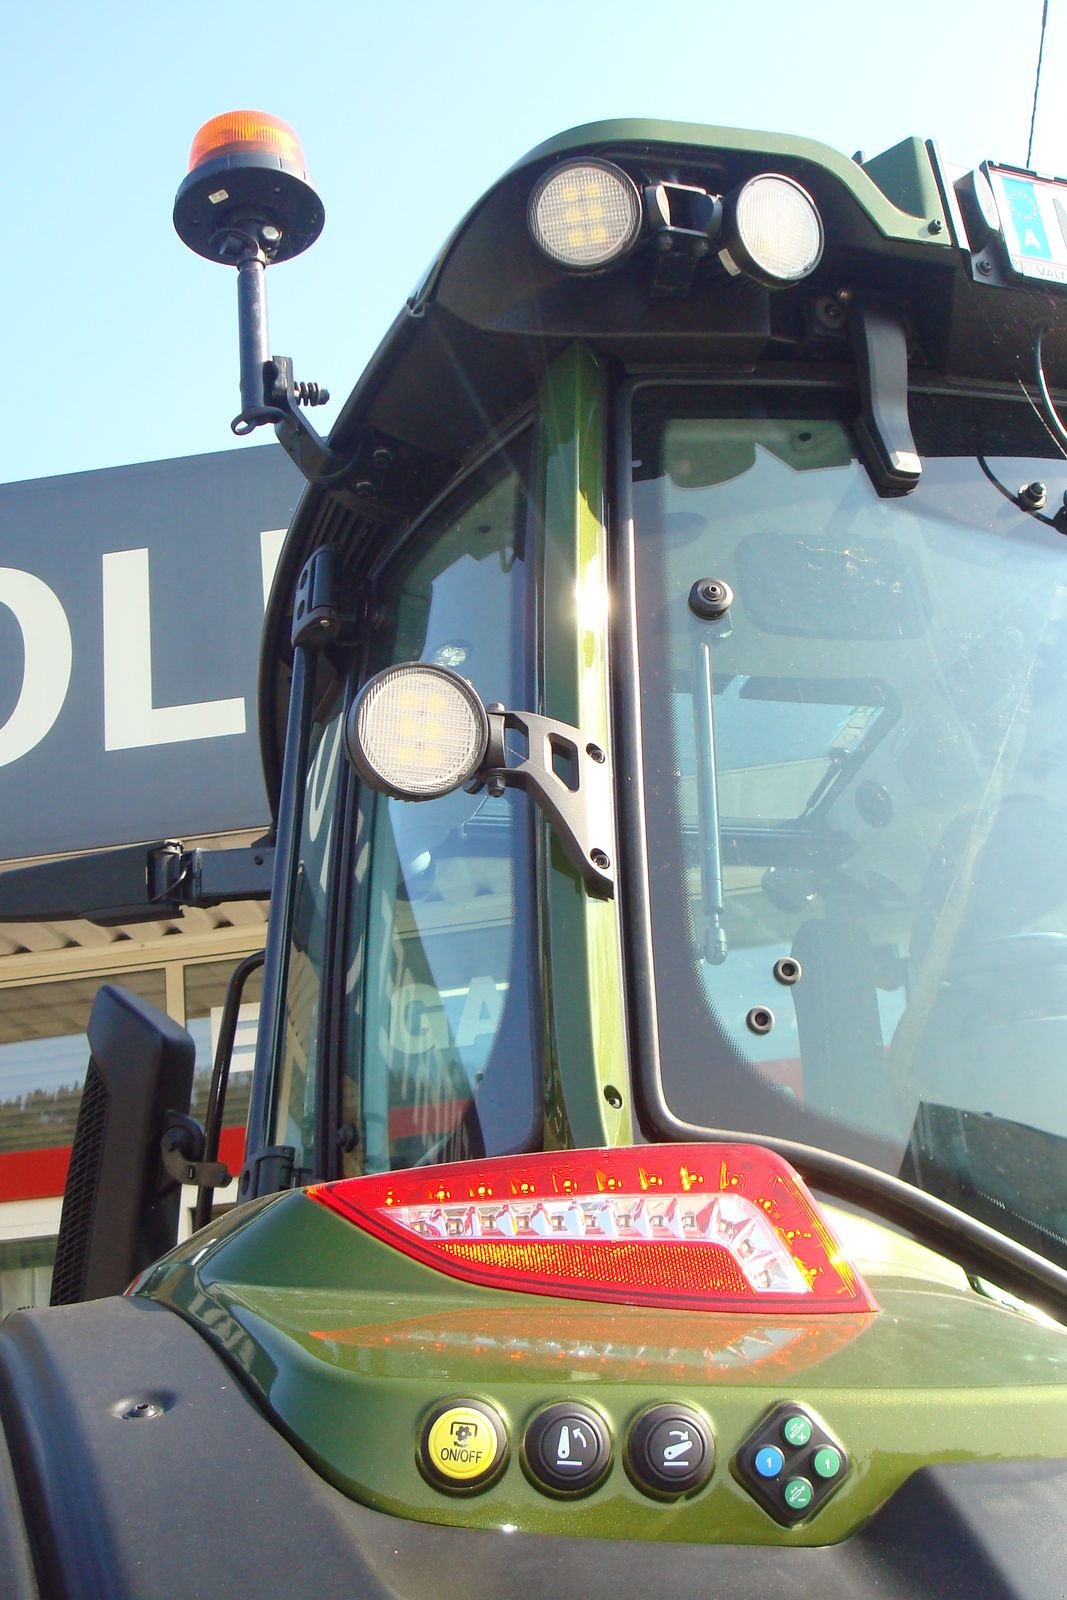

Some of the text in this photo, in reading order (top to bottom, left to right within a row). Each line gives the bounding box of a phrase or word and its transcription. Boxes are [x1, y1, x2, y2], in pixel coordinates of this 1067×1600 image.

[1024, 229, 1041, 249] A
[0, 528, 288, 768] OL
[440, 1447, 483, 1464] ON/OFF
[766, 1456, 773, 1469] 1
[824, 1458, 831, 1471] 1
